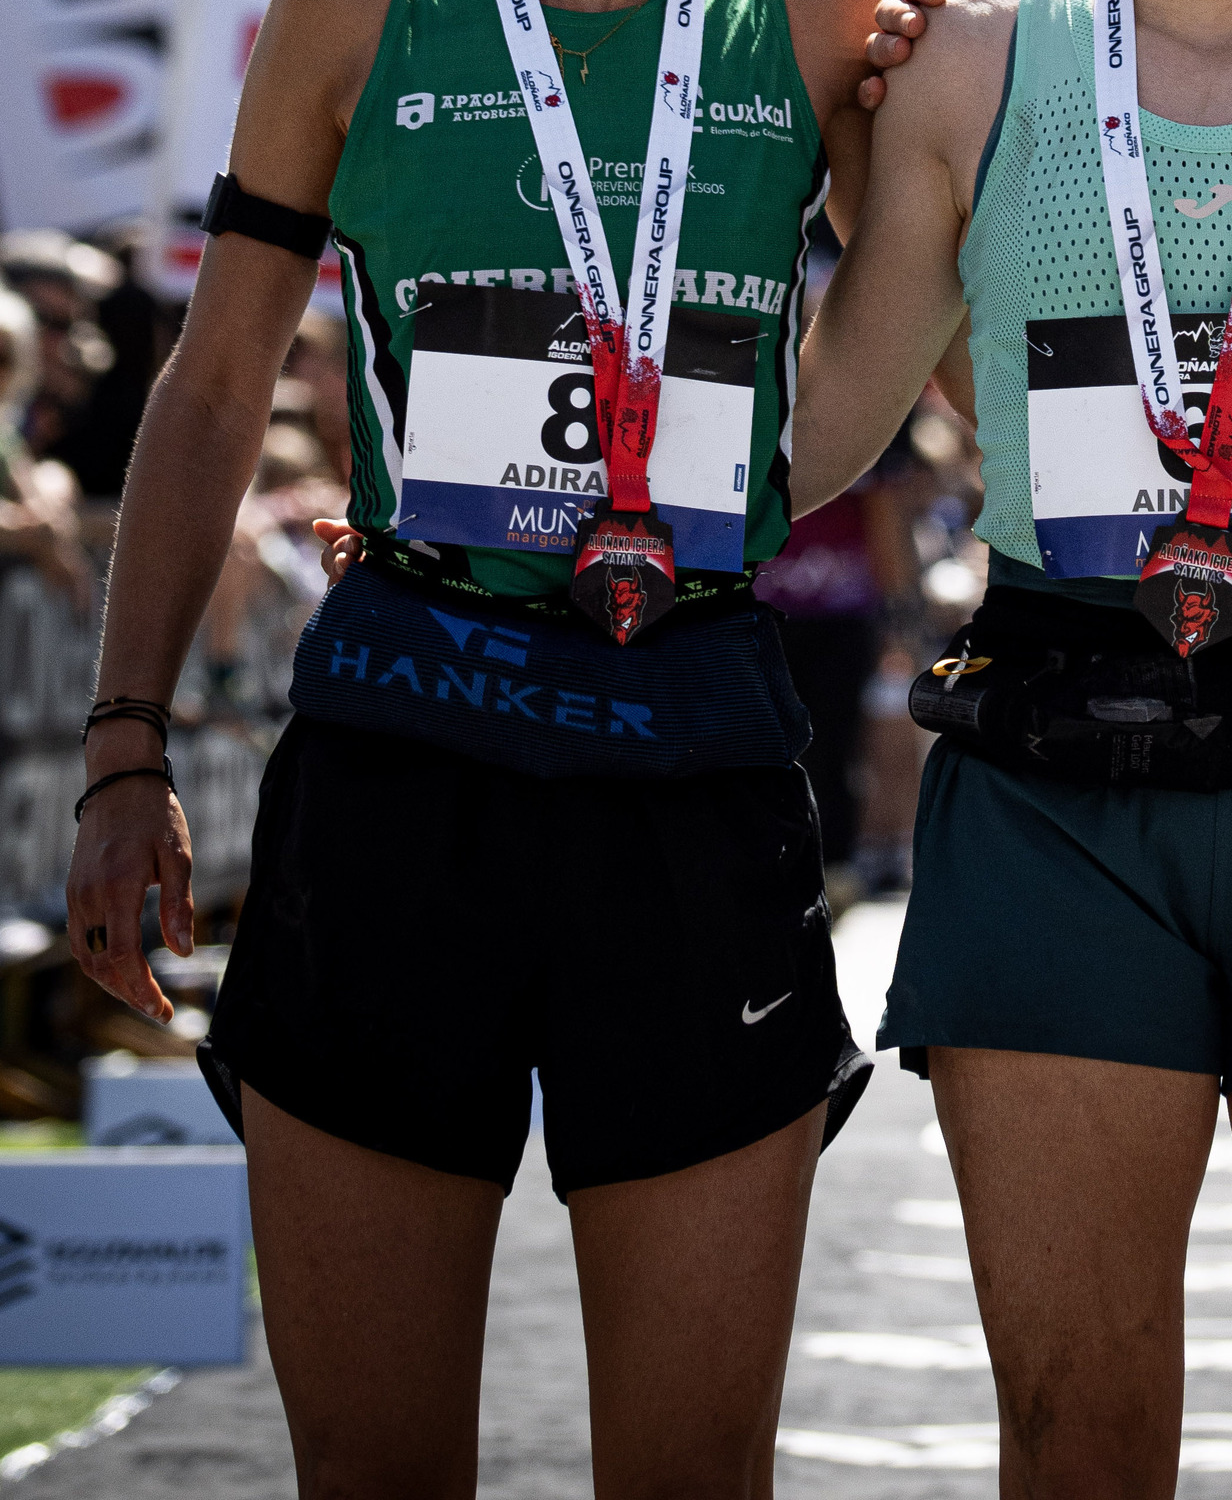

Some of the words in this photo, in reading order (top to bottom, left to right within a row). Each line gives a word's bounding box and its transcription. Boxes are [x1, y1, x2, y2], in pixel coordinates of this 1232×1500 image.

[440, 91, 523, 109] APAOLA
[525, 70, 542, 111] ALOÑAKO
[679, 75, 690, 120] ALOÑAKO
[453, 107, 527, 122] AUTOBUSA
[709, 94, 792, 129] auxkal
[710, 126, 748, 138] Elementos
[750, 130, 760, 138] de
[1124, 112, 1136, 158] ALOÑAKO
[590, 157, 696, 179] Premk
[558, 161, 595, 263] ONNERA
[586, 265, 616, 354] GROUP
[638, 246, 663, 351] ONNERA
[651, 157, 673, 243] GROUP
[1123, 207, 1151, 298] GROUP
[671, 268, 787, 315] ARAIA
[547, 351, 583, 361] IGOERA
[548, 339, 592, 354] ALOÑ
[1140, 299, 1170, 406] ONNERA
[541, 372, 604, 464] 8
[1207, 405, 1222, 457] ALOÑAKO
[499, 463, 650, 494] ADIRA
[508, 502, 580, 534] MUÑ
[507, 531, 576, 547] margoak
[588, 531, 631, 551] ALOÑAKO
[632, 536, 665, 555] IGOERA
[1158, 543, 1208, 566] ALOÑAKO
[603, 553, 647, 567] SATANAS
[1173, 563, 1224, 584] SATANAS
[326, 639, 659, 740] HANKER
